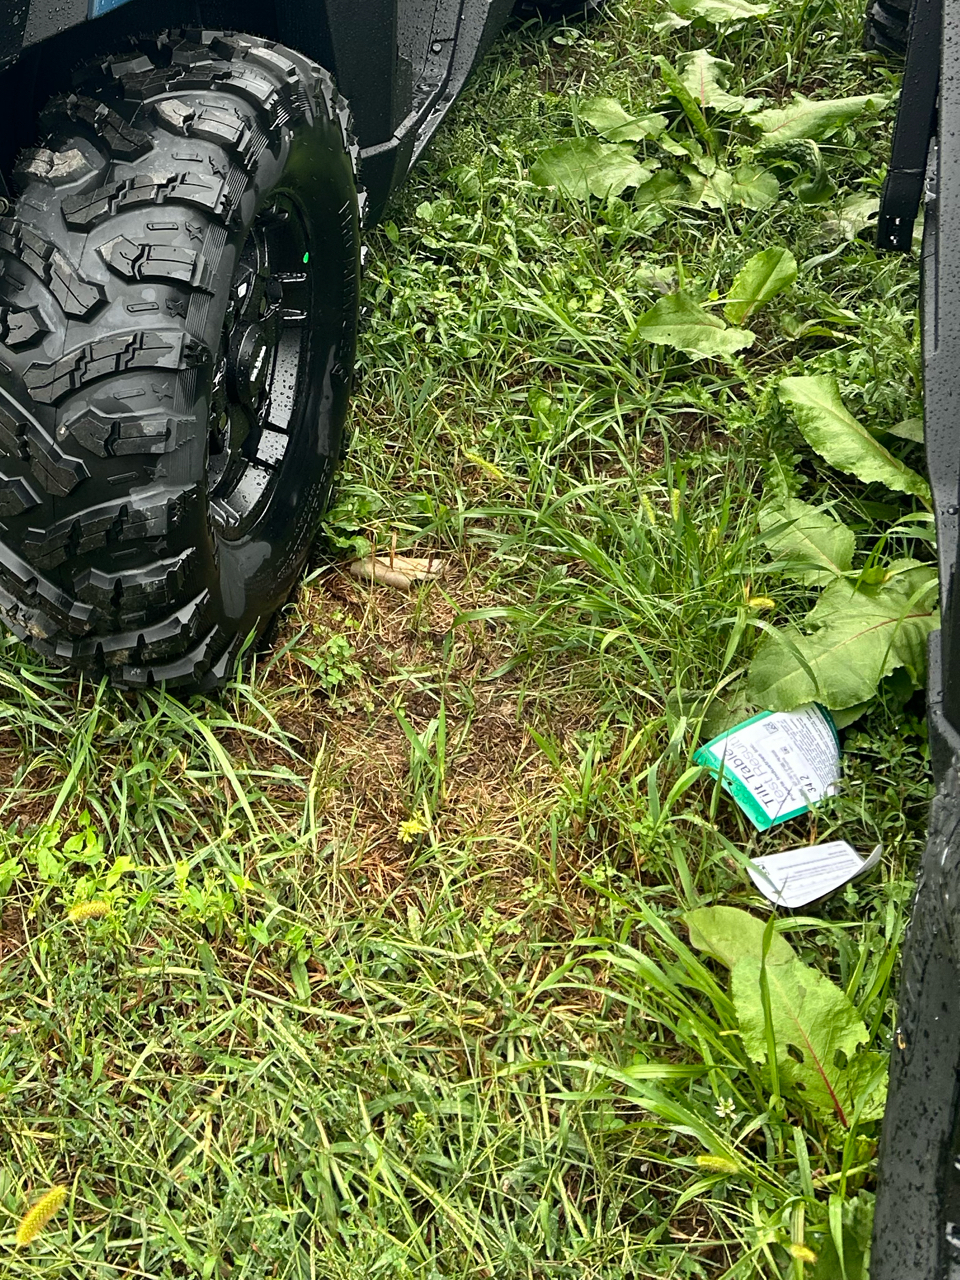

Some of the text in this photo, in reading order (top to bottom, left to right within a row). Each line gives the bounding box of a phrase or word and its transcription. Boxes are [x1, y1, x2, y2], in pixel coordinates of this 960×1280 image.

[725, 748, 775, 808] Tilt Table
[763, 777, 787, 805] Test
